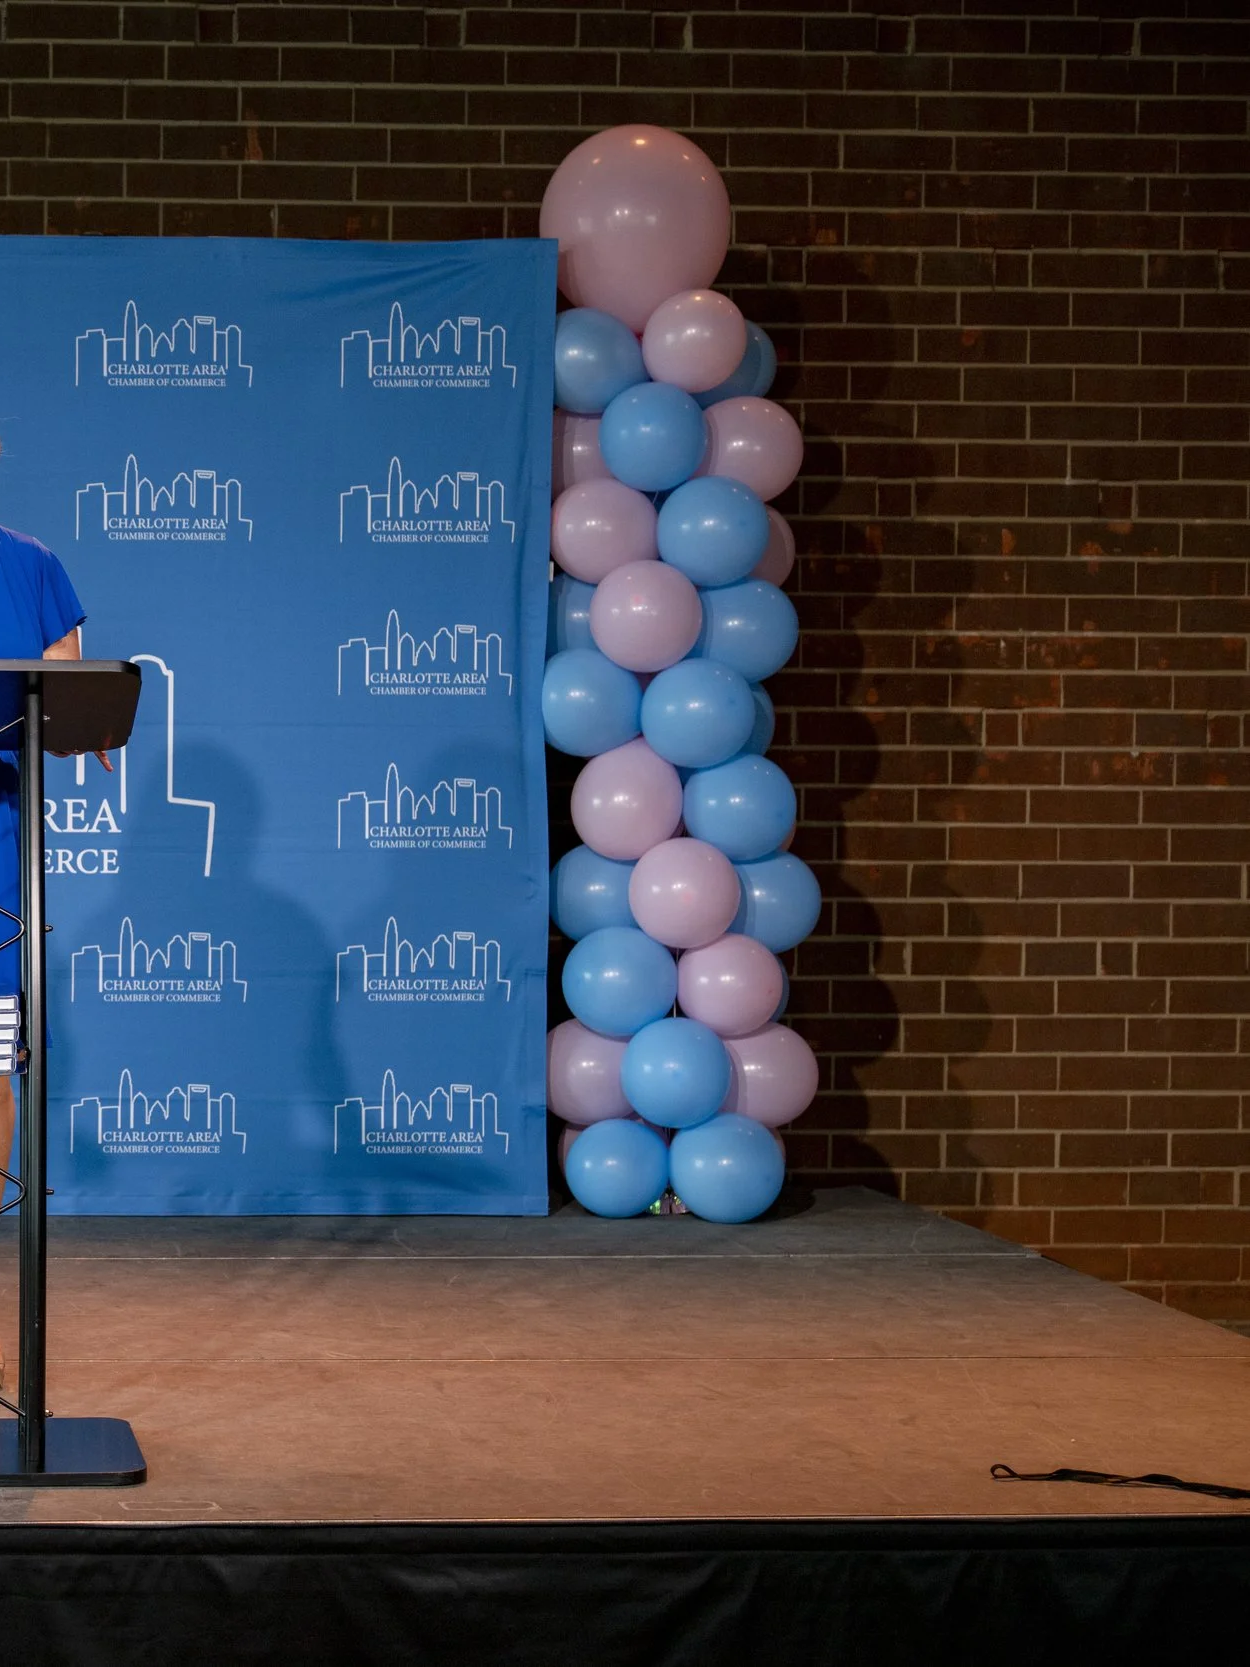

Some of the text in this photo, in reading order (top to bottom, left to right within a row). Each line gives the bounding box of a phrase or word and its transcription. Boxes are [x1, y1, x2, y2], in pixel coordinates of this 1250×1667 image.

[108, 363, 226, 376] CHARLOTTE AREA
[373, 365, 490, 377] CHARLOTTE AREA
[107, 377, 226, 387] CHAMBER OF COMMERCE
[372, 379, 490, 388] CHAMBER OF COMMERCE
[108, 517, 226, 530] CHARLOTTE AREA
[372, 520, 489, 532] CHARLOTTE AREA
[108, 531, 226, 541] CHAMBER OF COMMERCE
[371, 534, 488, 543] CHAMBER OF COMMERCE
[370, 672, 487, 684] CHARLOTTE AREA
[370, 686, 487, 696] CHAMBER OF COMMERCE
[44, 798, 122, 833] REA
[369, 826, 487, 838] CHARLOTTE AREA
[369, 839, 486, 849] CHAMBER OF COMMERCE
[103, 979, 221, 991] CHARLOTTE AREA
[368, 979, 484, 991] CHARLOTTE AREA
[103, 993, 221, 1002] CHAMBER OF COMMERCE
[368, 993, 485, 1002] CHAMBER OF COMMERCE
[102, 1131, 221, 1143] CHARLOTTE AREA
[366, 1131, 483, 1143] CHARLOTTE AREA
[102, 1145, 220, 1154] CHAMBER OF COMMERCE
[366, 1145, 484, 1154] CHAMBER OF COMMERCE
